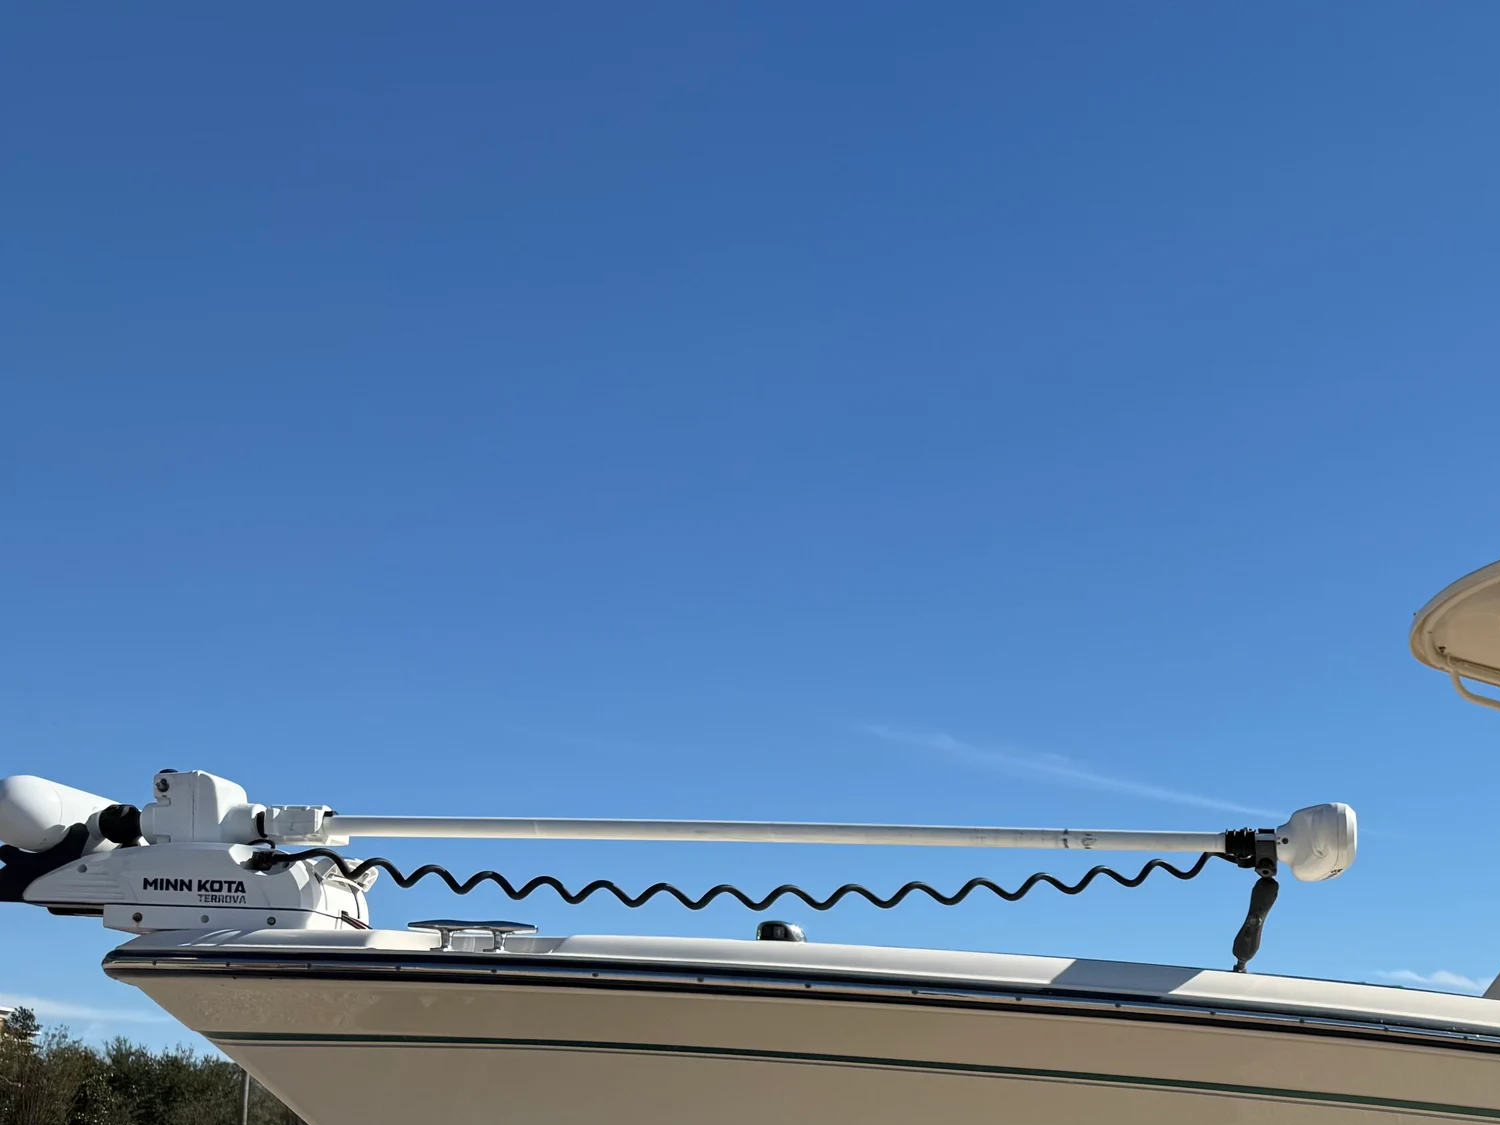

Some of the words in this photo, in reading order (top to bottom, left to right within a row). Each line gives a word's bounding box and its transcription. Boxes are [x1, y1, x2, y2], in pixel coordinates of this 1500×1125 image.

[143, 877, 192, 892] MINN
[197, 879, 246, 894] KOTA
[197, 894, 247, 904] TERROVA
